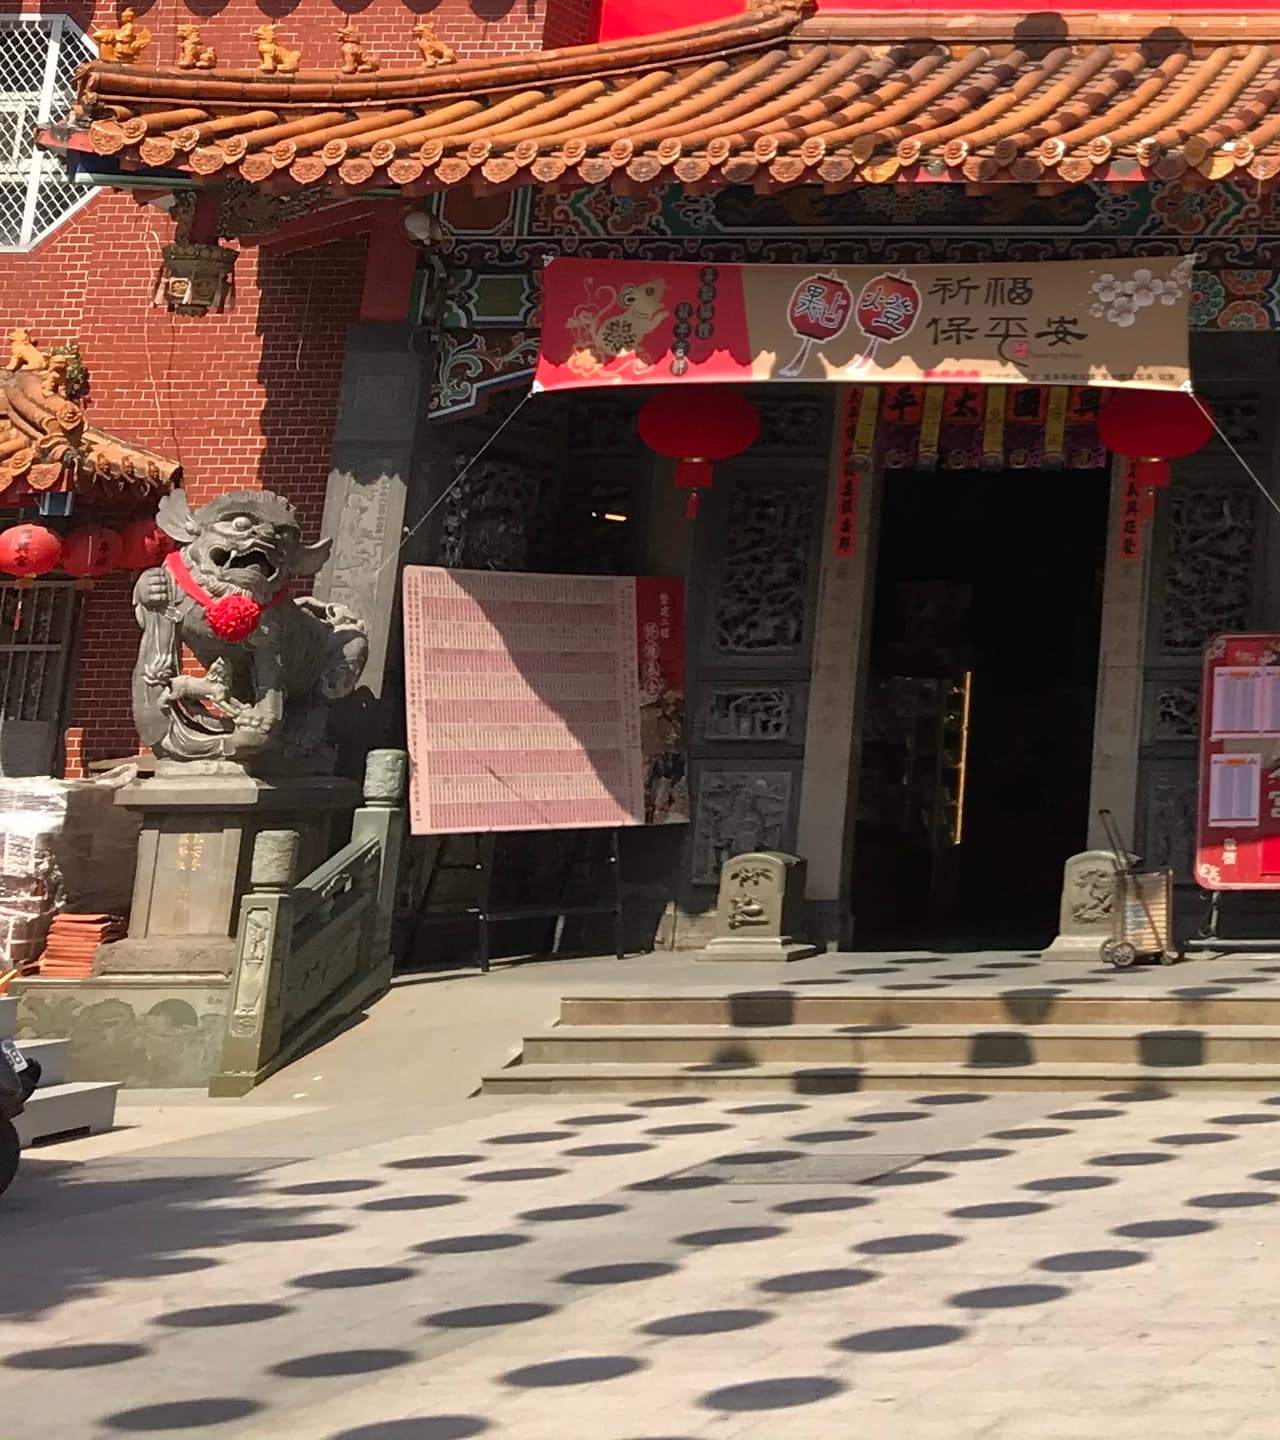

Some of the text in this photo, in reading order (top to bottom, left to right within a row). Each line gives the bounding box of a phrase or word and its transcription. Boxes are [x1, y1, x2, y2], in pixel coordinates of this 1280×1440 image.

[796, 284, 915, 334] 點燈
[928, 276, 1034, 306] 祈福
[927, 315, 1087, 367] 保平安
